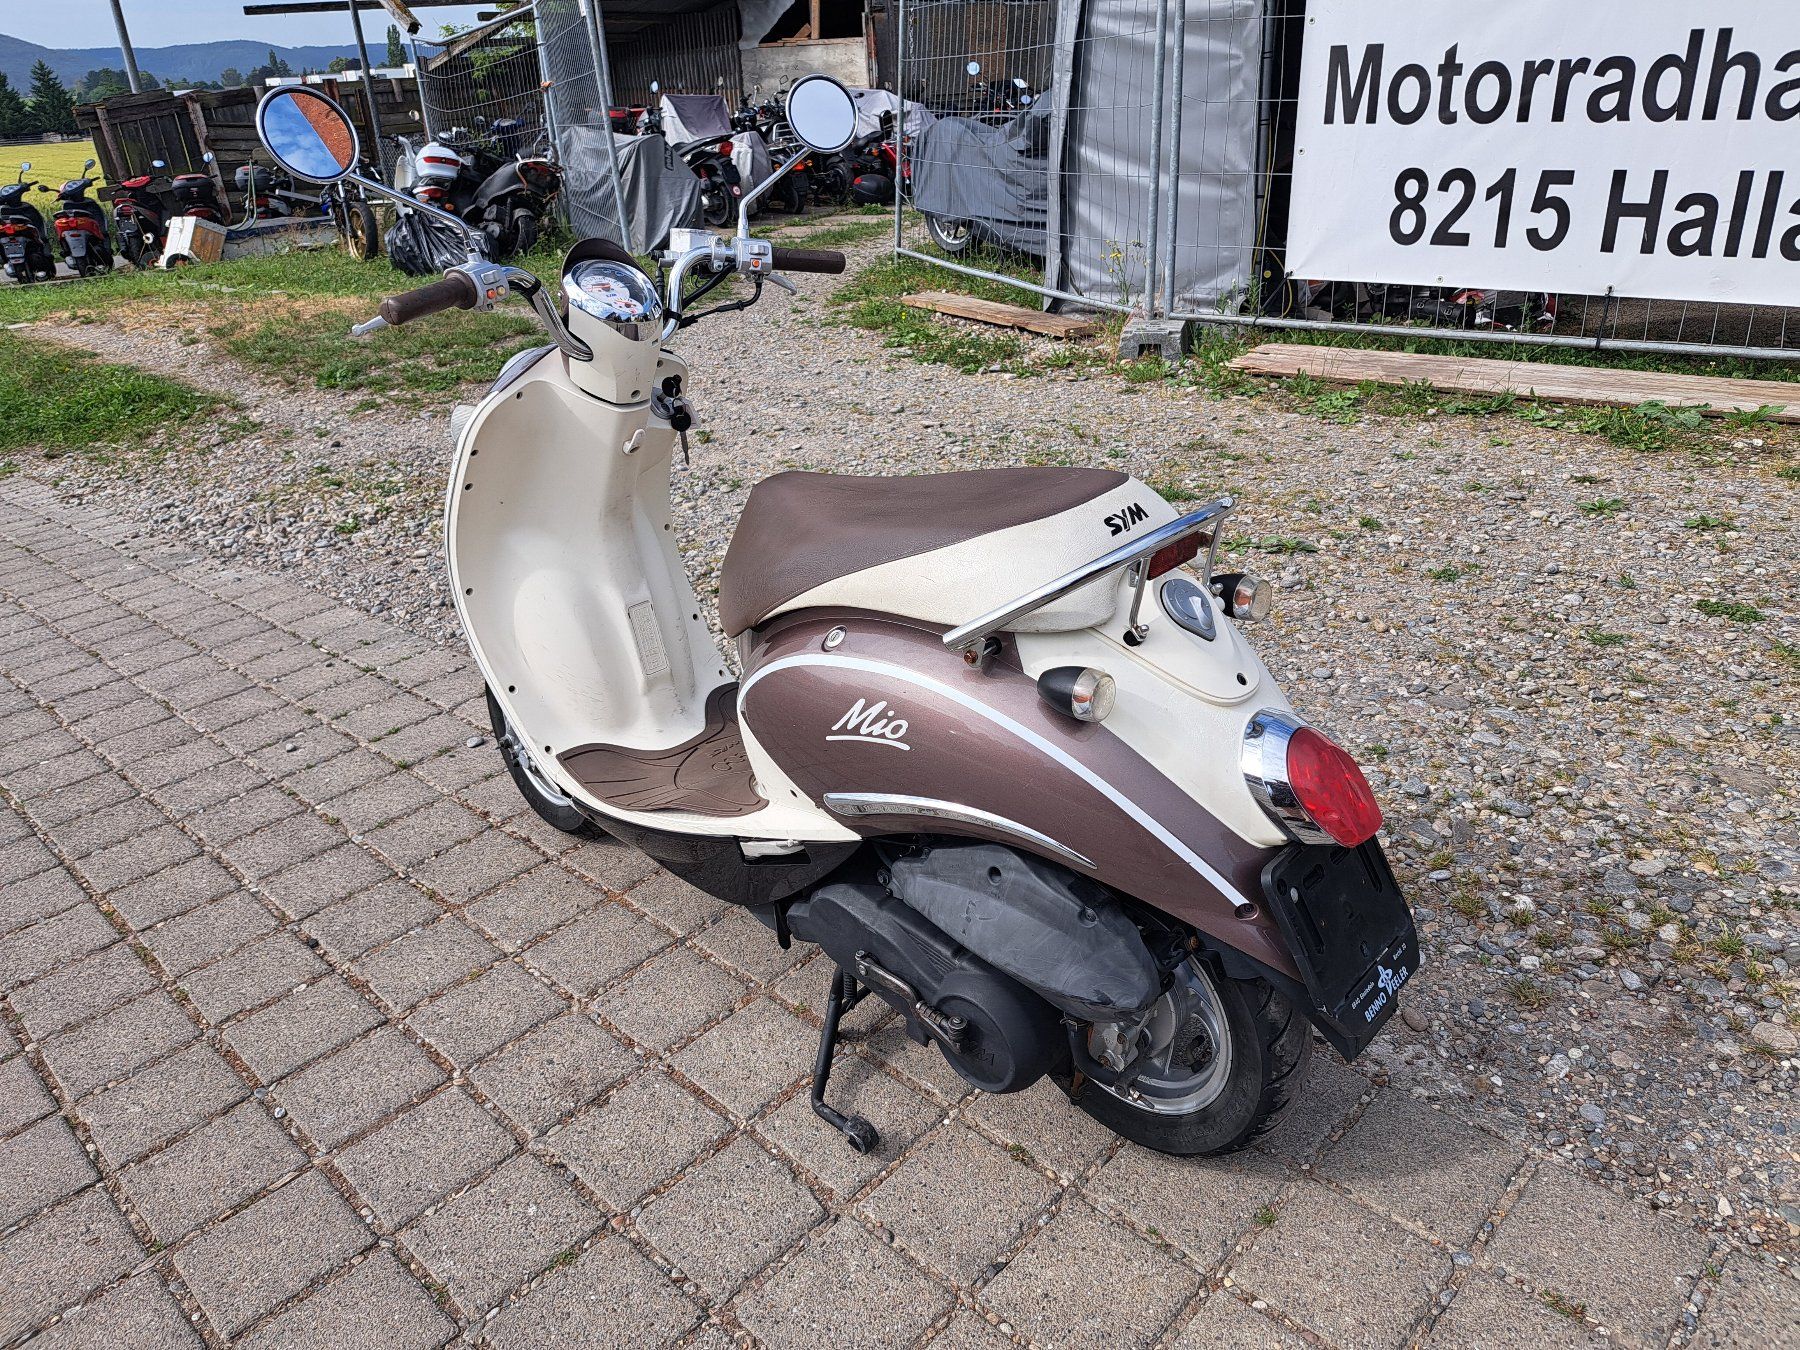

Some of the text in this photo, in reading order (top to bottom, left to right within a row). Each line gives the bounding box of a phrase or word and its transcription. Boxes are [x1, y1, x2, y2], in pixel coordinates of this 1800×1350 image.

[1323, 27, 1800, 125] Motorradha
[1388, 167, 1576, 252] 8215
[1103, 502, 1150, 537] SYM
[831, 698, 909, 739] Mio
[1364, 991, 1387, 1022] BENNO
